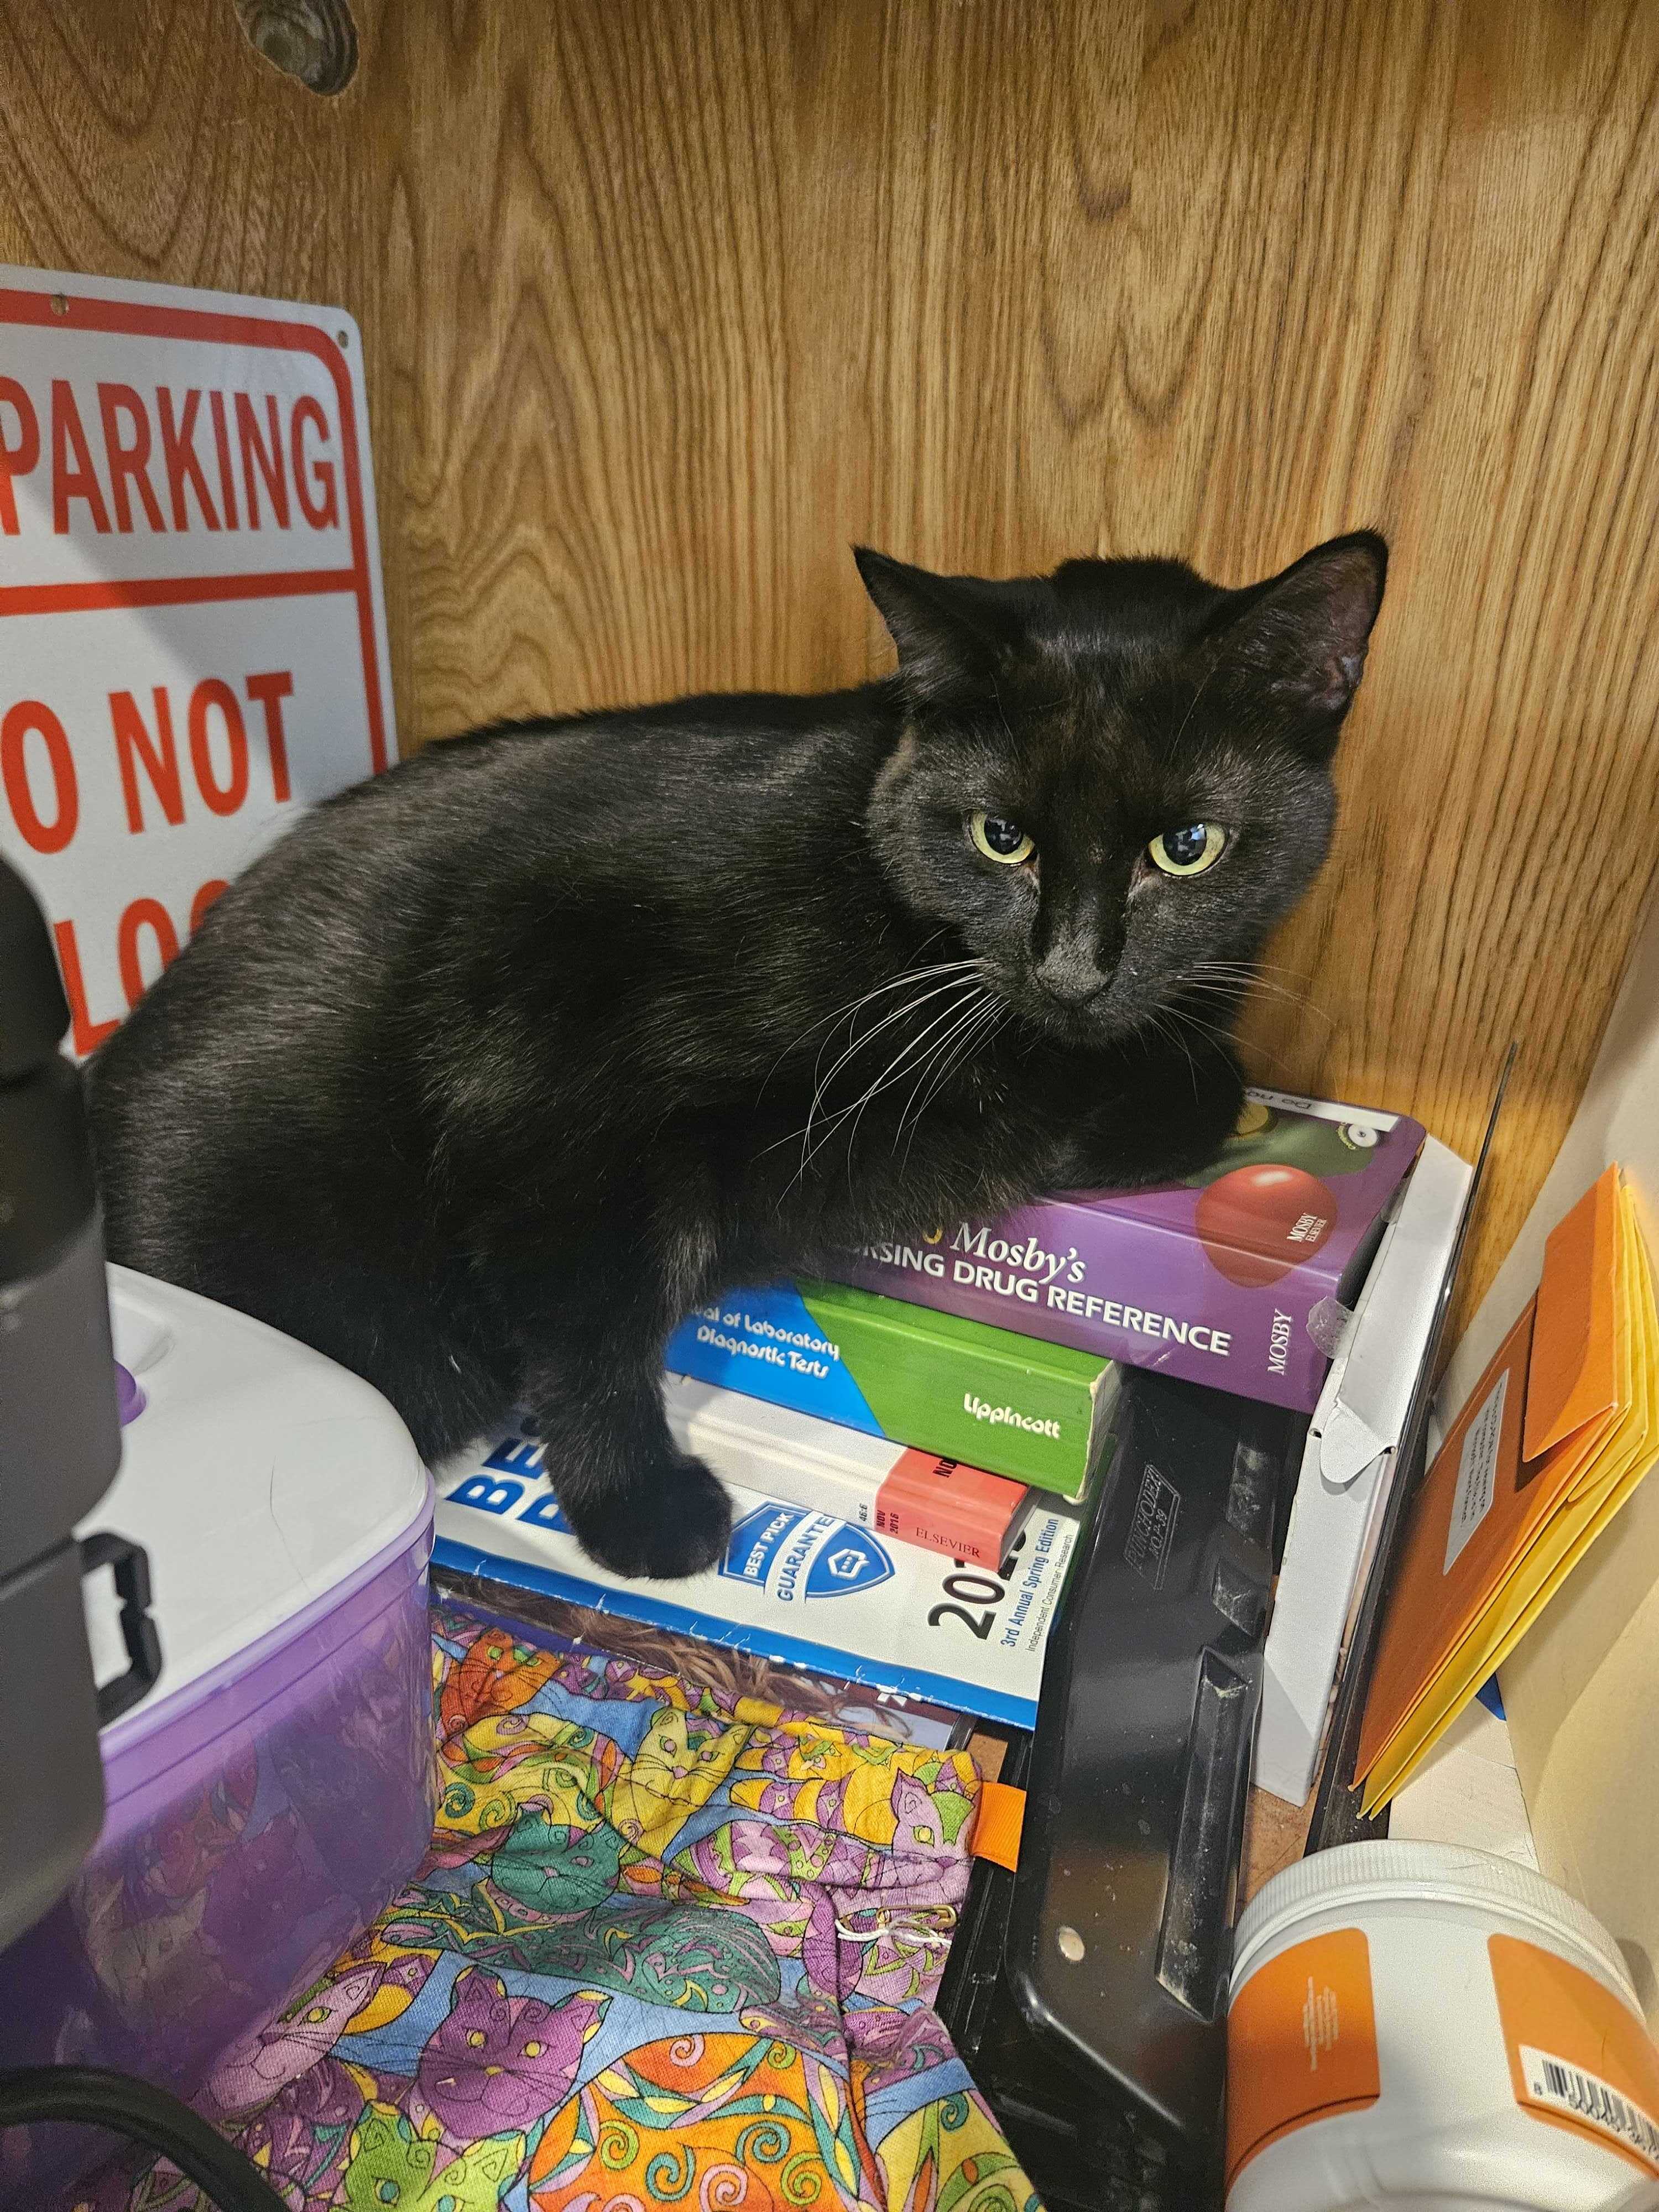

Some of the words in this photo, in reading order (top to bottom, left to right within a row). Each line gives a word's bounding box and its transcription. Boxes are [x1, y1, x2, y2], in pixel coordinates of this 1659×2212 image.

[0, 375, 340, 536] PARKING
[108, 671, 294, 835] NOT
[54, 879, 230, 1057] LO
[949, 1222, 1086, 1285] Mosby's
[1286, 1212, 1318, 1243] MOSBY
[953, 1259, 1039, 1303] DRUG
[1047, 1285, 1232, 1357] REFERENCE
[697, 1325, 786, 1367] Diagnostic
[787, 1350, 830, 1379] Tests
[723, 1312, 742, 1328] of
[744, 1314, 840, 1361] Laboratory
[1267, 1308, 1292, 1376] MOSBY
[963, 1392, 1061, 1439] Lippincott
[444, 1432, 549, 1515] BE
[859, 1503, 868, 1522] 46:6
[875, 1509, 886, 1529] NOV
[889, 1512, 900, 1535] 2016
[1035, 1518, 1059, 1554] Edition
[743, 1541, 768, 1577] BEST
[760, 1512, 795, 1543] PICK
[776, 1514, 834, 1601] GUARANTE
[915, 1526, 981, 1558] ELSEVIER
[927, 1530, 1026, 1641] 20
[1022, 1556, 1049, 1588] Spring
[1025, 1606, 1049, 1652] Independent
[1042, 1570, 1060, 1605] Consumer
[1055, 1533, 1074, 1569] Research
[1008, 1589, 1034, 1627] Annual
[1000, 1628, 1020, 1647] 3rd
